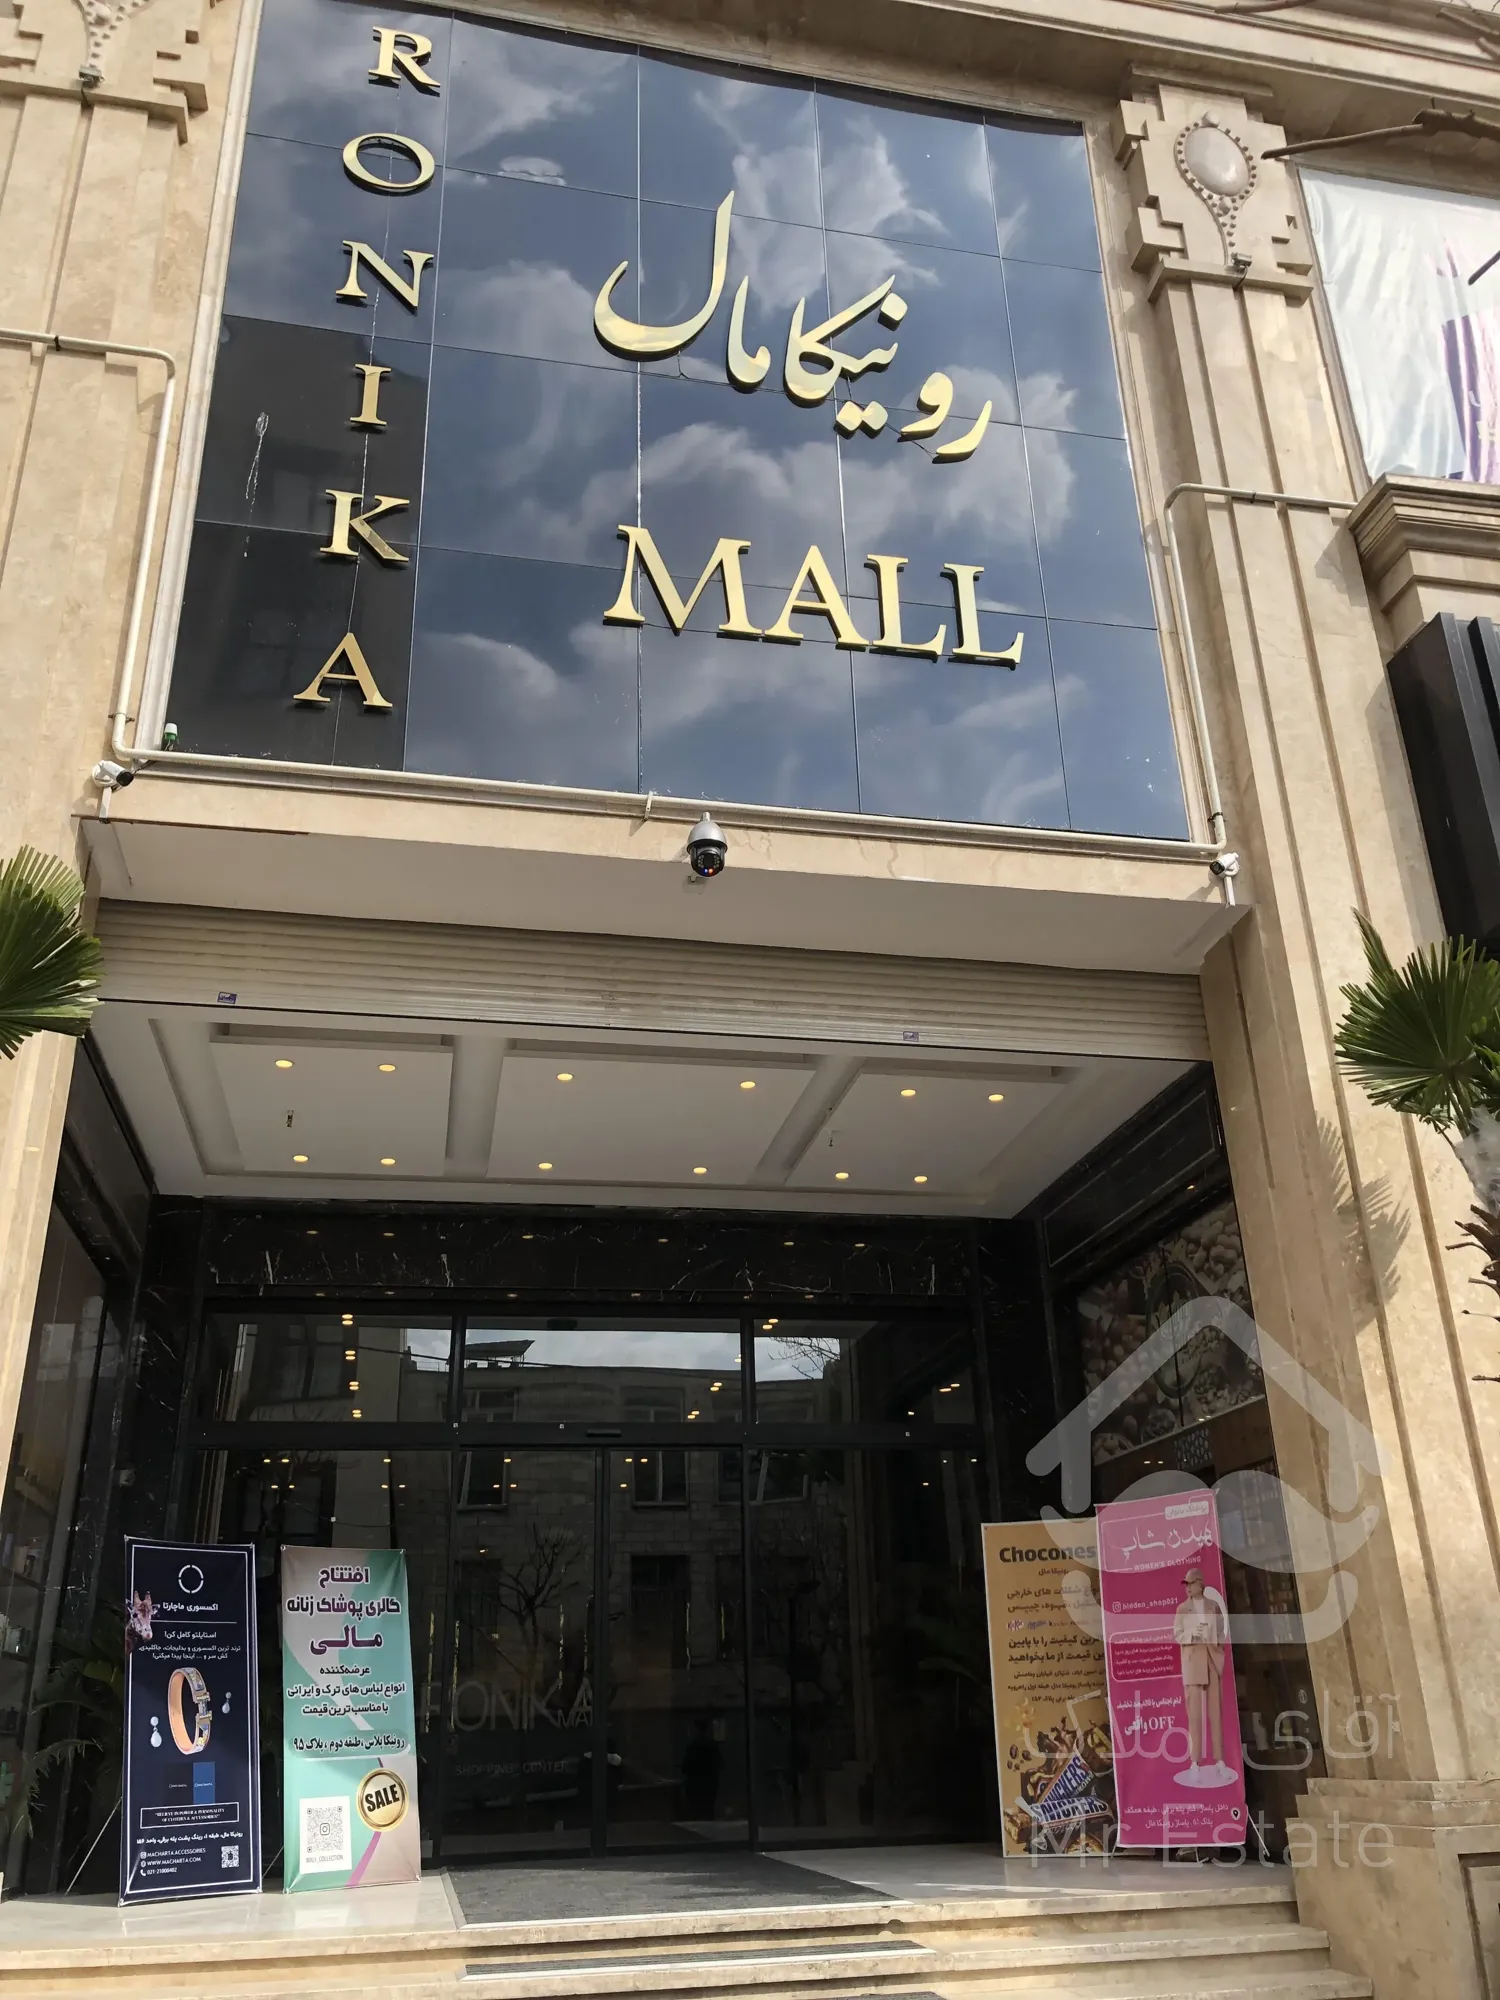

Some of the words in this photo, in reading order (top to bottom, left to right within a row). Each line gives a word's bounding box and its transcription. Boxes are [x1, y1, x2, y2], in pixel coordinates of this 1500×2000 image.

[294, 26, 441, 710] RONIKA
[603, 524, 1024, 669] MALL
[1133, 1561, 1166, 1571] WOMEN'S
[1167, 1556, 1202, 1567] CLOTHING
[319, 1567, 369, 1588] افتتاح
[1006, 1588, 1033, 1600] خارجی
[1034, 1587, 1052, 1598] های
[162, 1602, 185, 1612] ماچارتا
[186, 1603, 219, 1612] اکسسوری
[287, 1595, 314, 1616] زنانه
[316, 1593, 364, 1620] پوشاک
[310, 1624, 384, 1656] مالی
[1050, 1634, 1078, 1647] کیفیت
[1008, 1652, 1045, 1664] بخواهید
[1046, 1652, 1056, 1660] ما
[1057, 1652, 1064, 1662] از
[1066, 1650, 1091, 1661] قیمت
[287, 1685, 314, 1697] ایرانی
[315, 1688, 321, 1697] و
[321, 1684, 341, 1697] ترک
[341, 1684, 360, 1696] های
[360, 1683, 383, 1696] لباس
[383, 1683, 406, 1698] انواع
[302, 1704, 328, 1717] قیمت
[329, 1705, 351, 1716] ترین
[352, 1703, 382, 1715] مناسب
[381, 1702, 389, 1715] با
[1148, 1715, 1175, 1730] OFF
[383, 1734, 405, 1749] رونیکا
[364, 1783, 400, 1812] SALE
